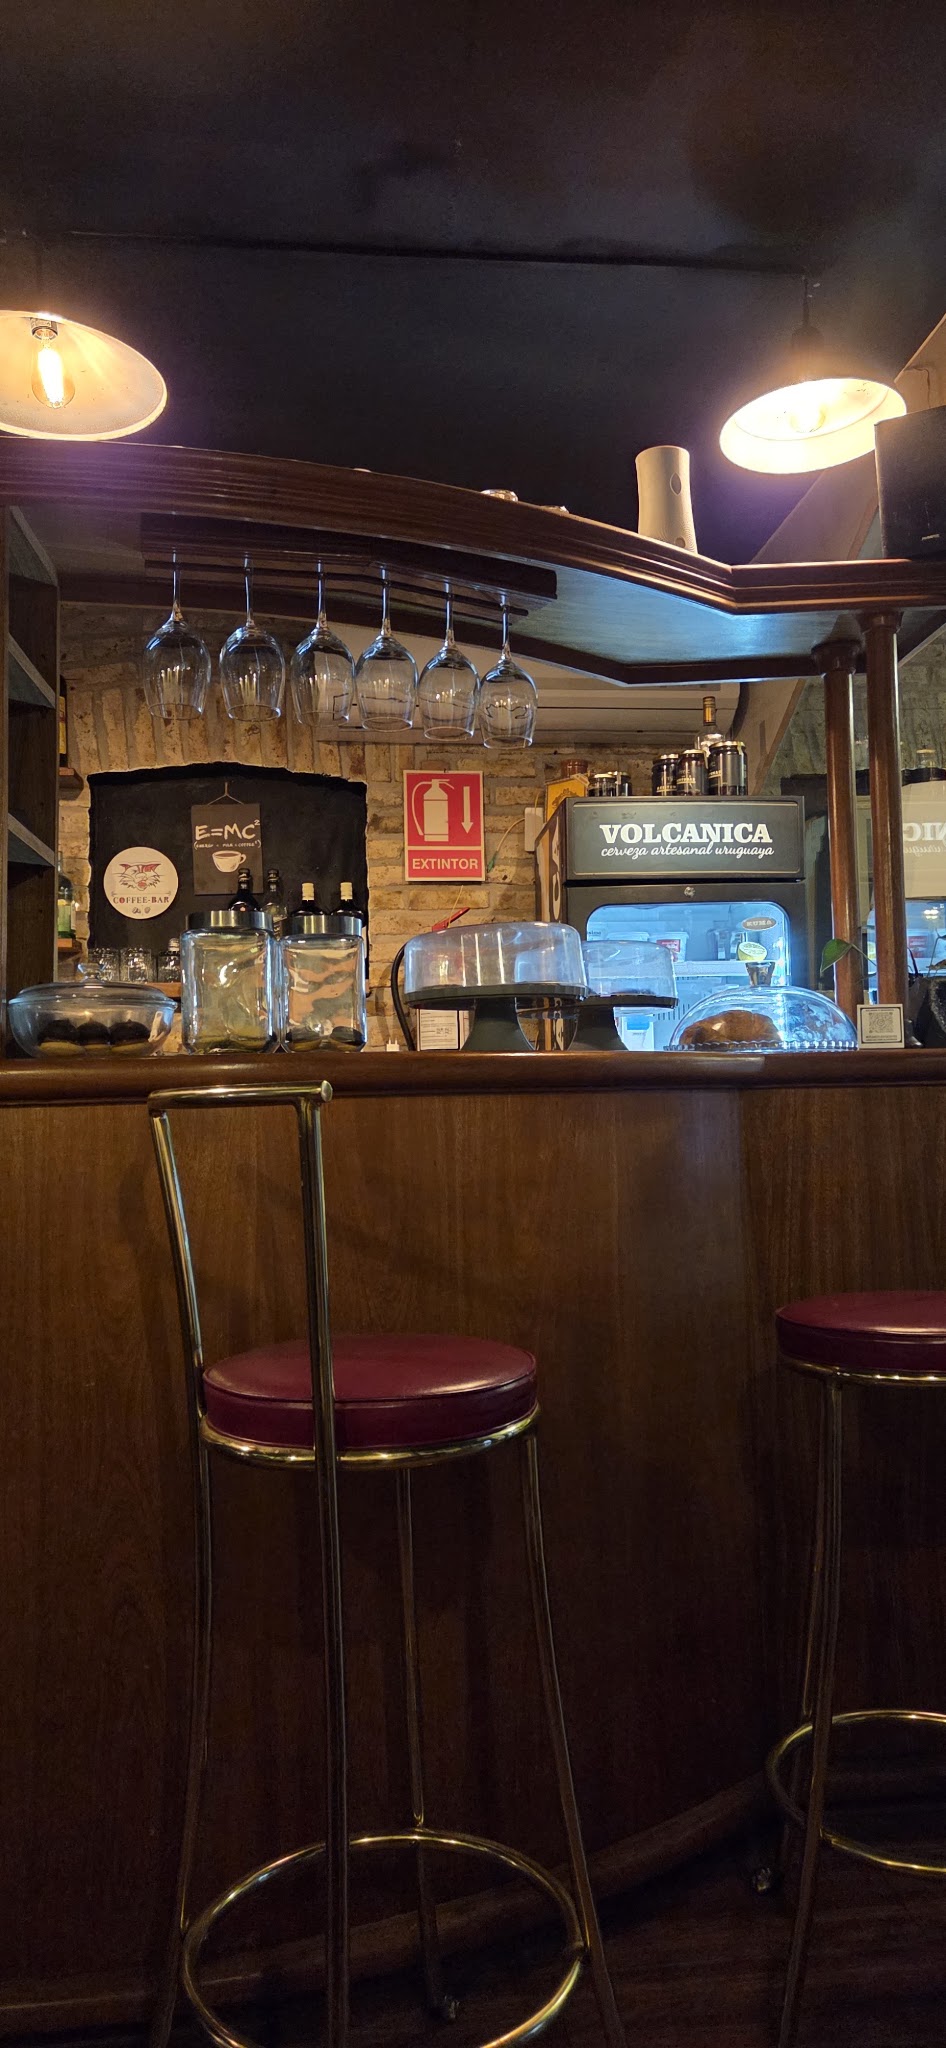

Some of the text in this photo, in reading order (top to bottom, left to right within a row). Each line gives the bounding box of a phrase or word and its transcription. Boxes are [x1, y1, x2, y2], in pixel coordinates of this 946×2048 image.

[599, 823, 773, 844] VOLCANICA
[601, 842, 774, 860] cerveza artesanal uruguaya
[412, 858, 479, 870] EXTINTOR
[113, 896, 170, 904] COFFEE-BAR
